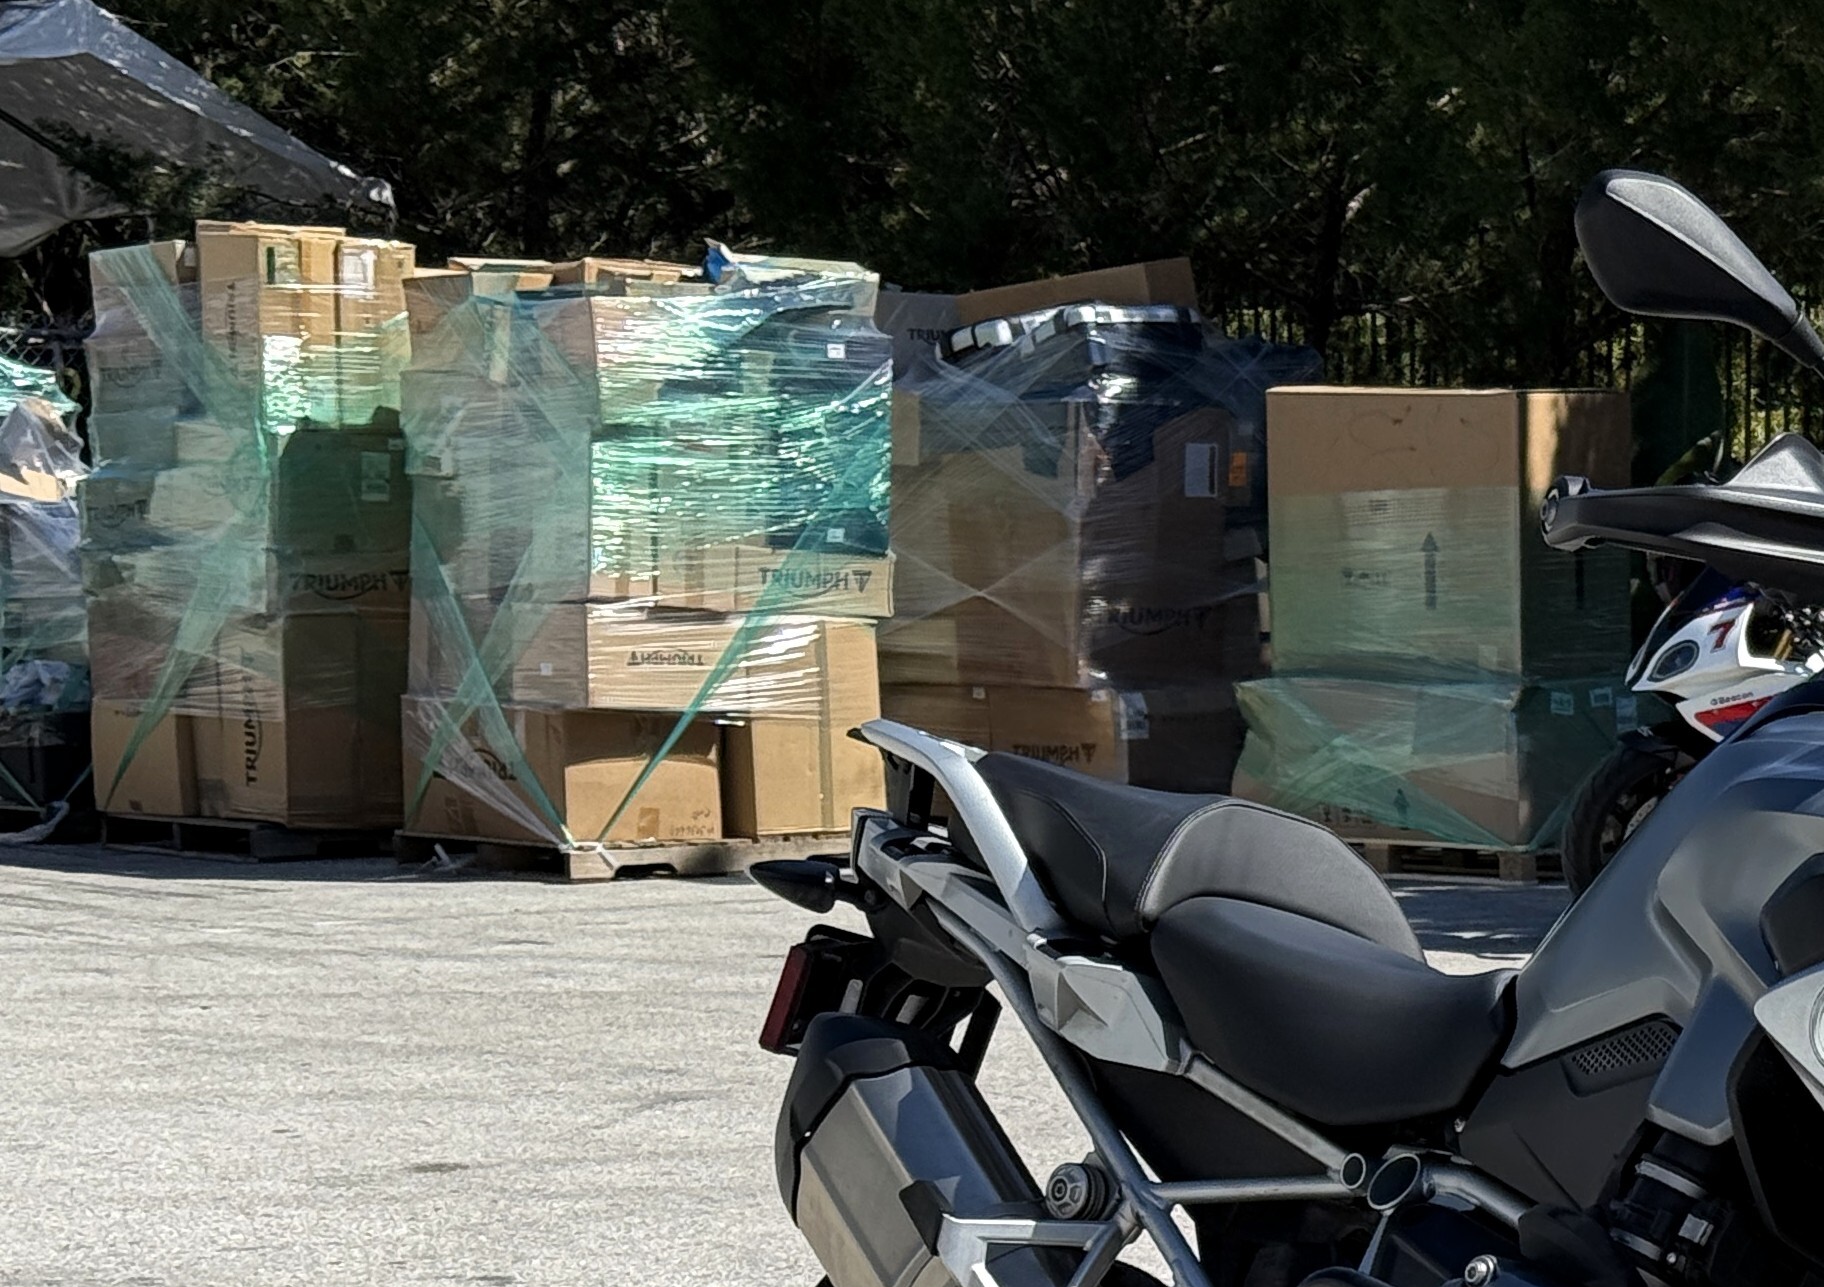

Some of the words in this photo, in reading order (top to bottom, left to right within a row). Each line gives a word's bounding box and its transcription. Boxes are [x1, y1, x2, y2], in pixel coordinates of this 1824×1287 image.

[907, 328, 948, 345] TRIU
[289, 573, 389, 600] TRIUMPH
[758, 567, 850, 597] TRIUMPH
[1100, 605, 1191, 634] RIUMPH
[1707, 618, 1737, 653] 7
[642, 649, 704, 666] TRIUMPH
[1012, 744, 1079, 765] TRIUMPH
